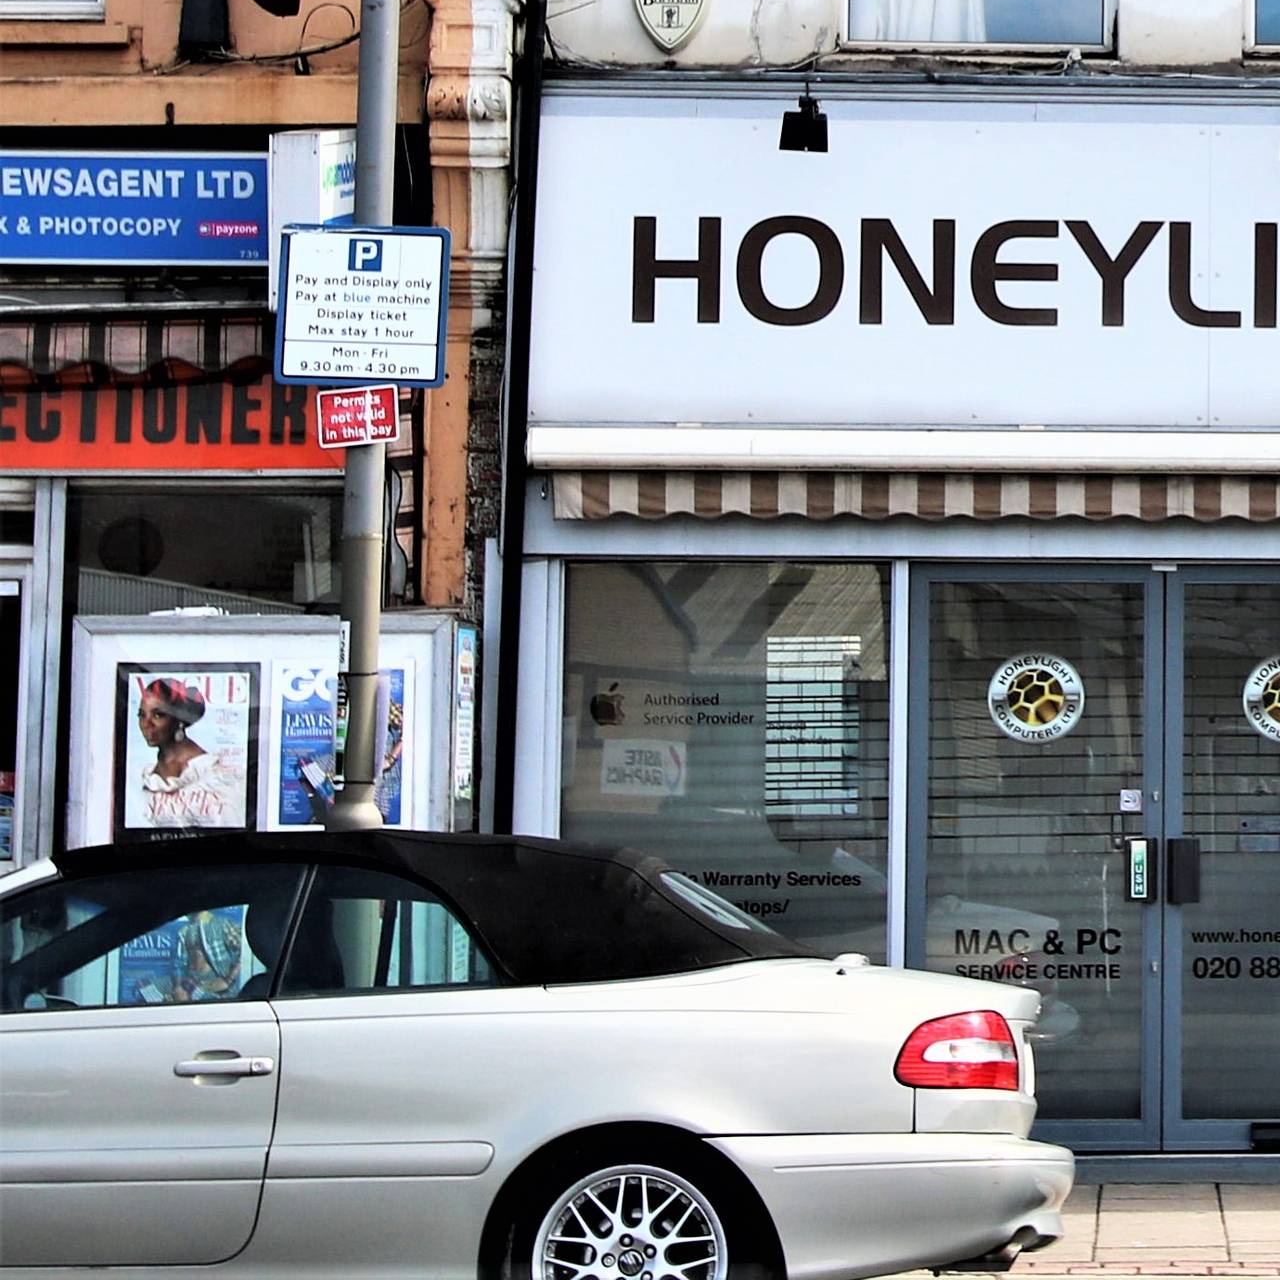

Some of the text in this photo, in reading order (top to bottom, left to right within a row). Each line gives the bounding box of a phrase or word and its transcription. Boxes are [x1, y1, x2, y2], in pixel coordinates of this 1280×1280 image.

[197, 170, 255, 199] LTD
[16, 217, 31, 235] &
[39, 217, 181, 236] PHOTOCOPY
[215, 223, 258, 236] payzone
[355, 241, 378, 270] P
[295, 274, 432, 290] Pay and Display only
[295, 290, 431, 305] Pay at blue machine
[317, 308, 408, 321] Display ticket
[308, 325, 334, 335] Max
[341, 327, 368, 338] stay
[385, 327, 415, 338] hour
[332, 347, 360, 358] Mon
[371, 348, 388, 358] Fri
[300, 361, 331, 372] 9.30
[334, 364, 354, 372] am
[365, 363, 396, 374] 4.30
[400, 366, 420, 375] pm
[333, 395, 380, 408] Permts
[331, 412, 352, 424] not
[325, 425, 392, 440] in this bay
[644, 693, 720, 707] Authorised
[285, 714, 332, 727] LEWIS
[644, 713, 693, 725] Service
[697, 712, 754, 725] Provider
[995, 704, 1076, 739] COMPUTERS LTD
[703, 871, 781, 889] Warranty
[787, 871, 862, 887] Services
[955, 929, 1122, 955] MAC & PC
[955, 964, 1121, 980] SERVICE CENTRE
[1192, 956, 1241, 979] 020
